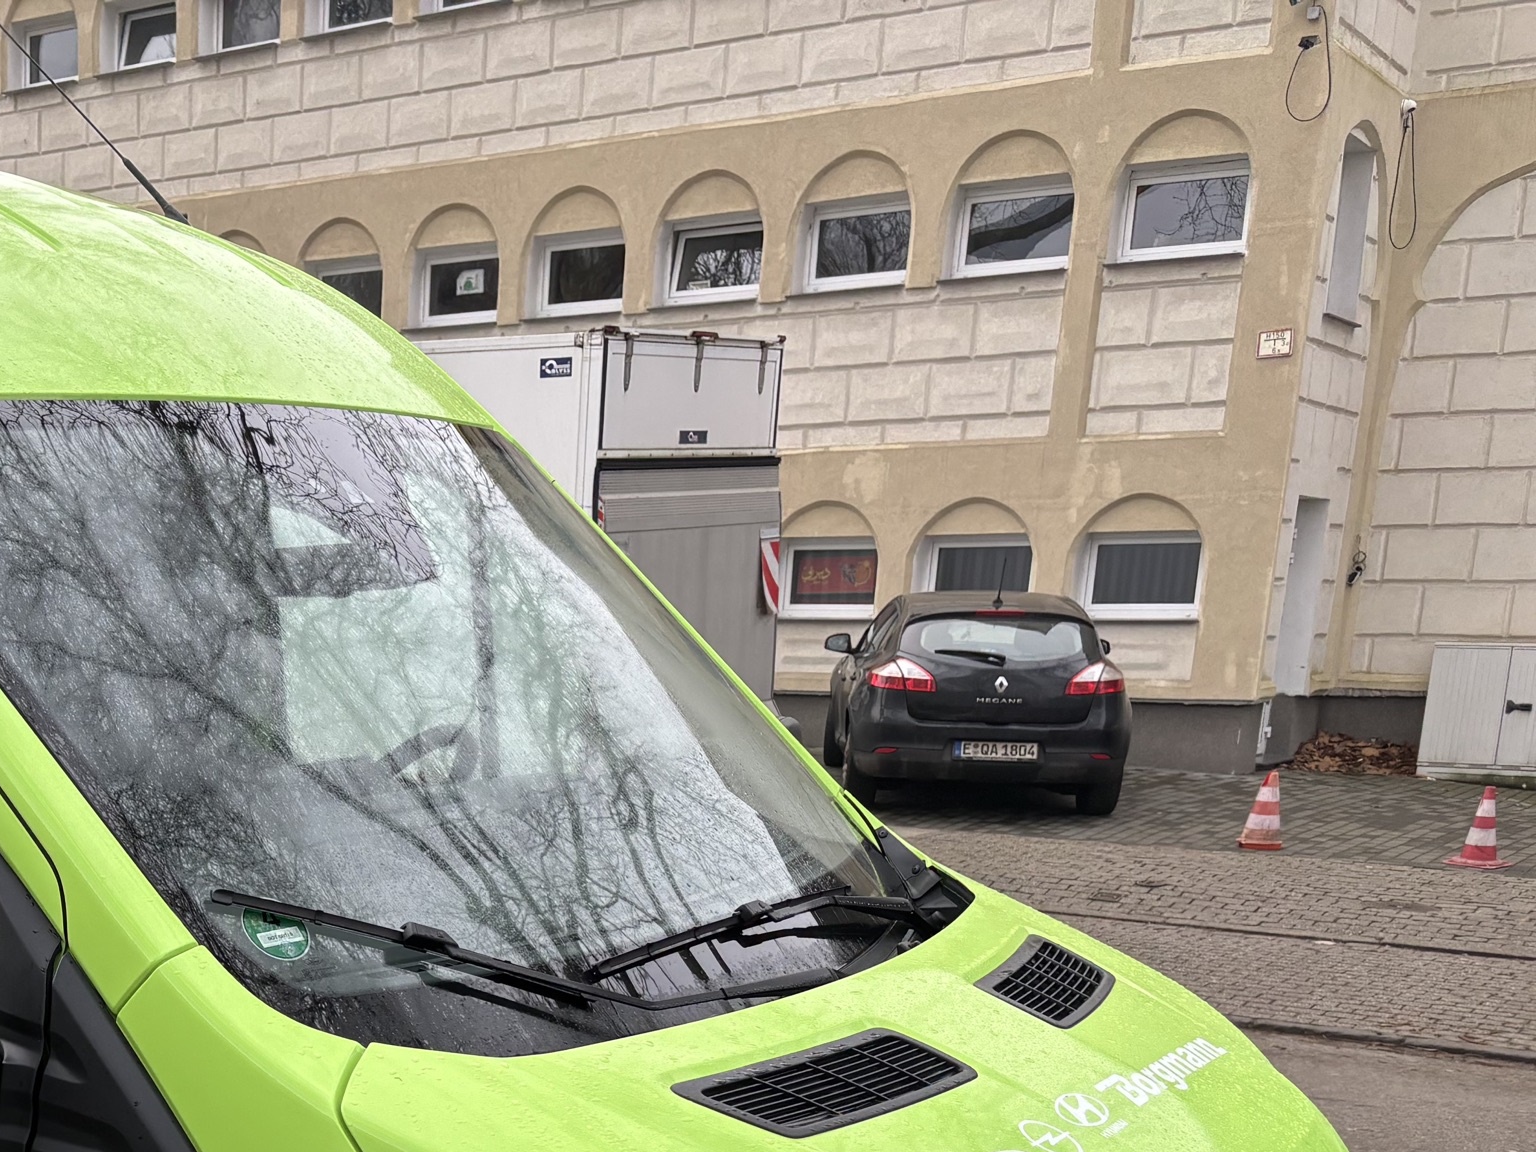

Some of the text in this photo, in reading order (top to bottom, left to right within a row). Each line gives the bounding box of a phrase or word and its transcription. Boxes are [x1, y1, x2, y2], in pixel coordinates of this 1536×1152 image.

[962, 742, 1035, 758] E QA 1804
[1093, 1036, 1229, 1108] Borgmann
